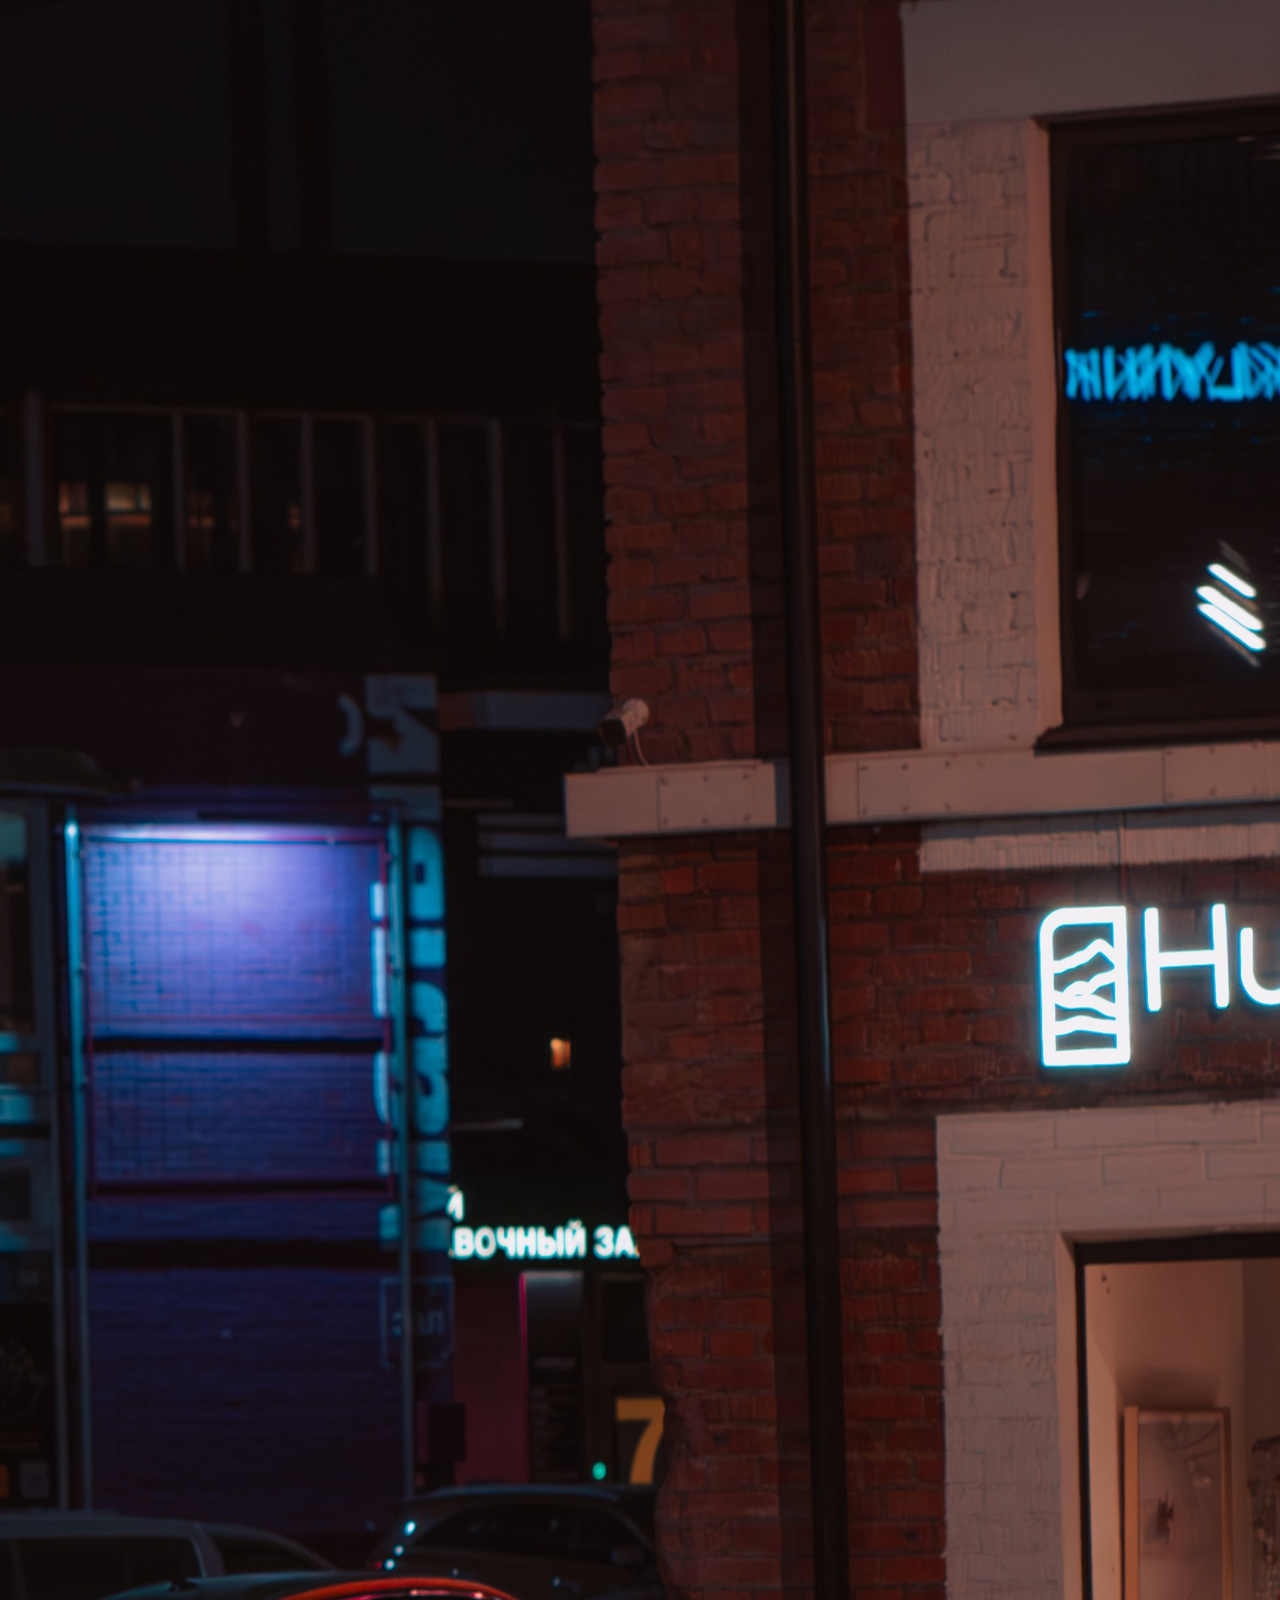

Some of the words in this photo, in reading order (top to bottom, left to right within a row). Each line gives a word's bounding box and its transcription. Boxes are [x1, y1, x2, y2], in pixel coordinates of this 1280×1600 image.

[449, 1218, 587, 1260] ВОЧНЫЙ
[593, 1223, 641, 1260] ЗА
[615, 1396, 665, 1485] 7
